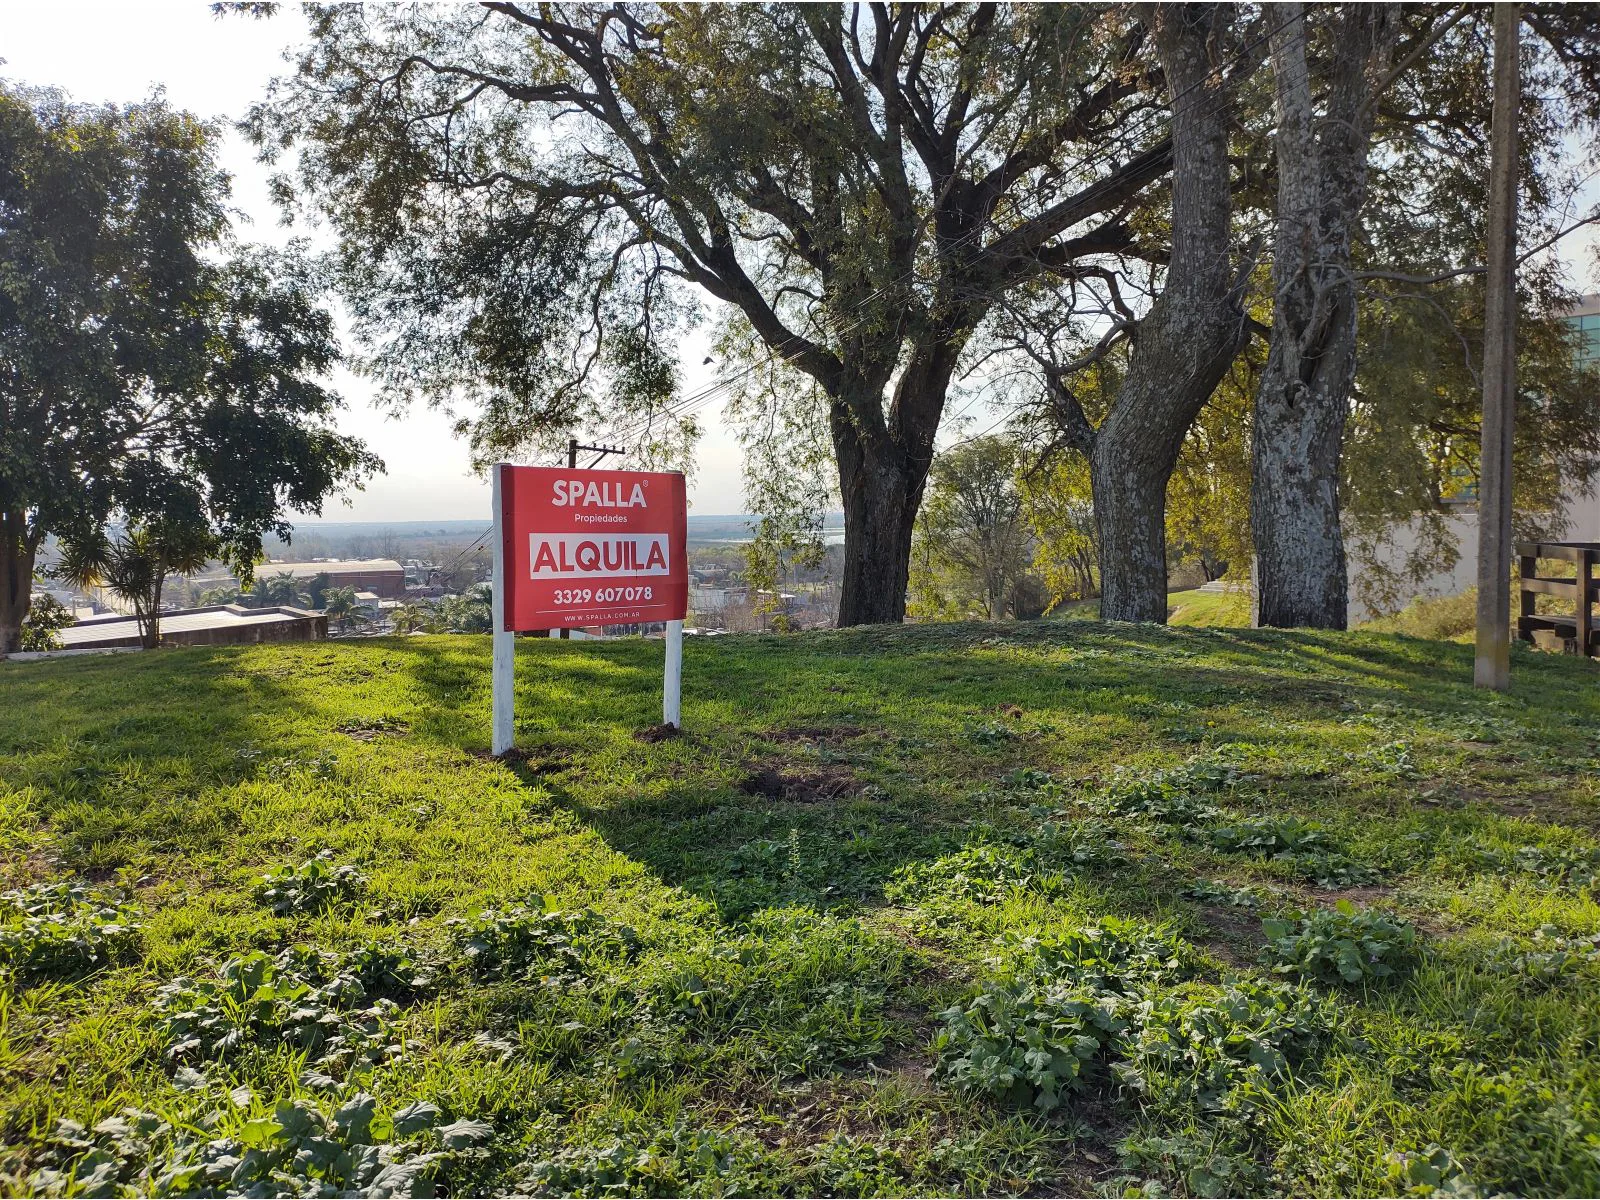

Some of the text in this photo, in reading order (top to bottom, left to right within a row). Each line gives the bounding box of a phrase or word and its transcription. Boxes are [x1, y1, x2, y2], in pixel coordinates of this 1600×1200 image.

[551, 479, 648, 508] SPALLA
[574, 513, 628, 524] Propiedades
[532, 540, 667, 572] ALQUILA
[553, 586, 653, 605] 3329 607078
[564, 611, 640, 622] WWW.SPALLA.COM.AR
